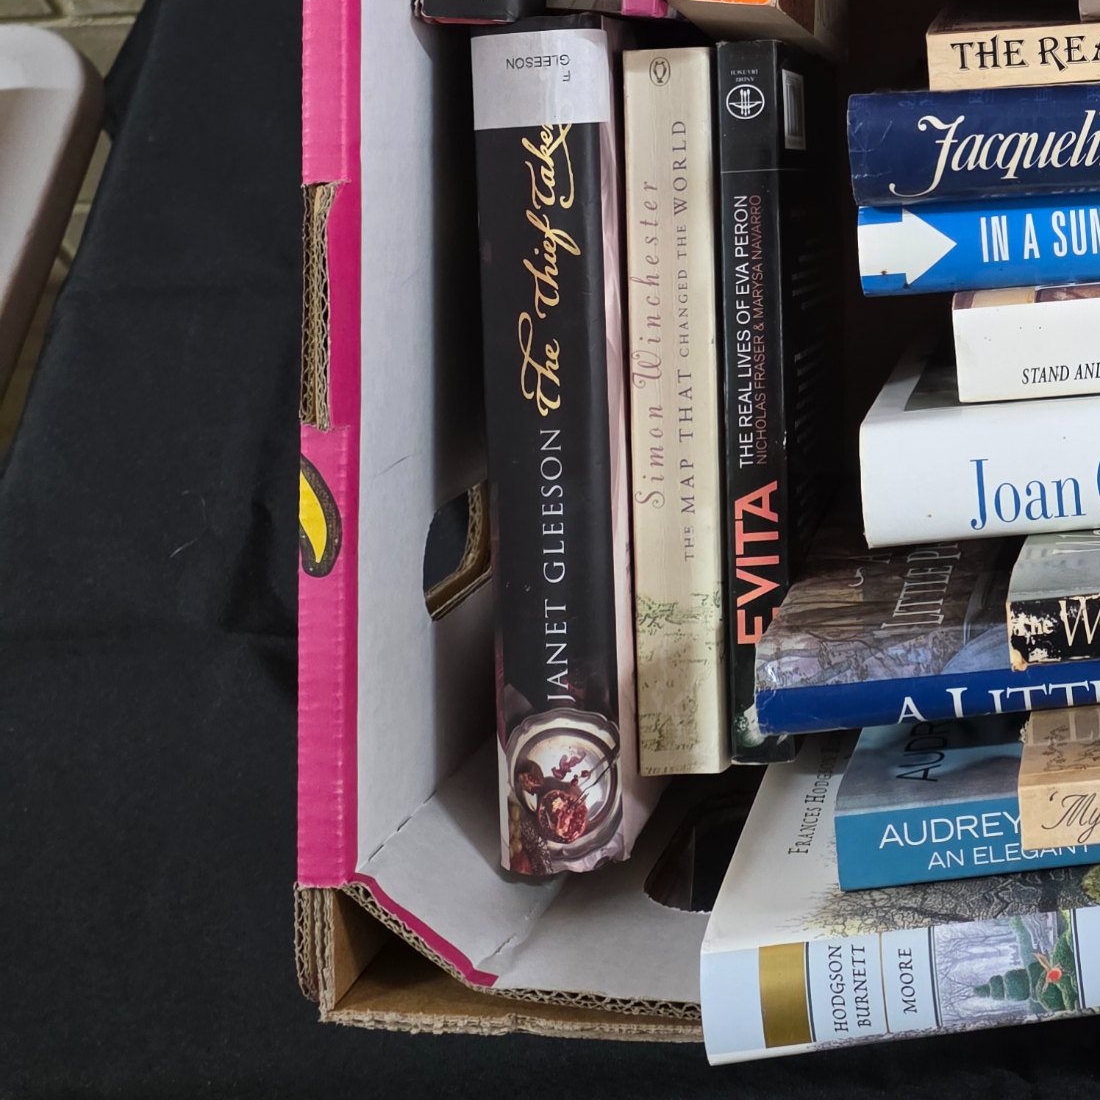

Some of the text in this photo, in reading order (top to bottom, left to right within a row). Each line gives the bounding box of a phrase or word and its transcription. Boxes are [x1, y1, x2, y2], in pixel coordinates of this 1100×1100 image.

[505, 53, 571, 70] GLEESON
[950, 34, 1025, 71] THE
[980, 214, 1010, 263] IN
[1022, 212, 1041, 260] A
[630, 181, 665, 509] Simon Winchester
[672, 120, 695, 562] THE MAP THAT CHANGED THE WORLD
[734, 195, 754, 469] THE REAL LIVES OF EVA PERON
[749, 195, 768, 465] NICHOLAS FRASER & MARYSA NAVARRO
[1021, 364, 1071, 385] STAND
[970, 457, 1086, 531] Joan
[735, 480, 780, 645] EVITA
[879, 811, 1021, 849] AUDREY
[828, 946, 849, 1033] HODGSON
[851, 944, 872, 1027] BURNETT
[899, 948, 917, 1013] MOORE
